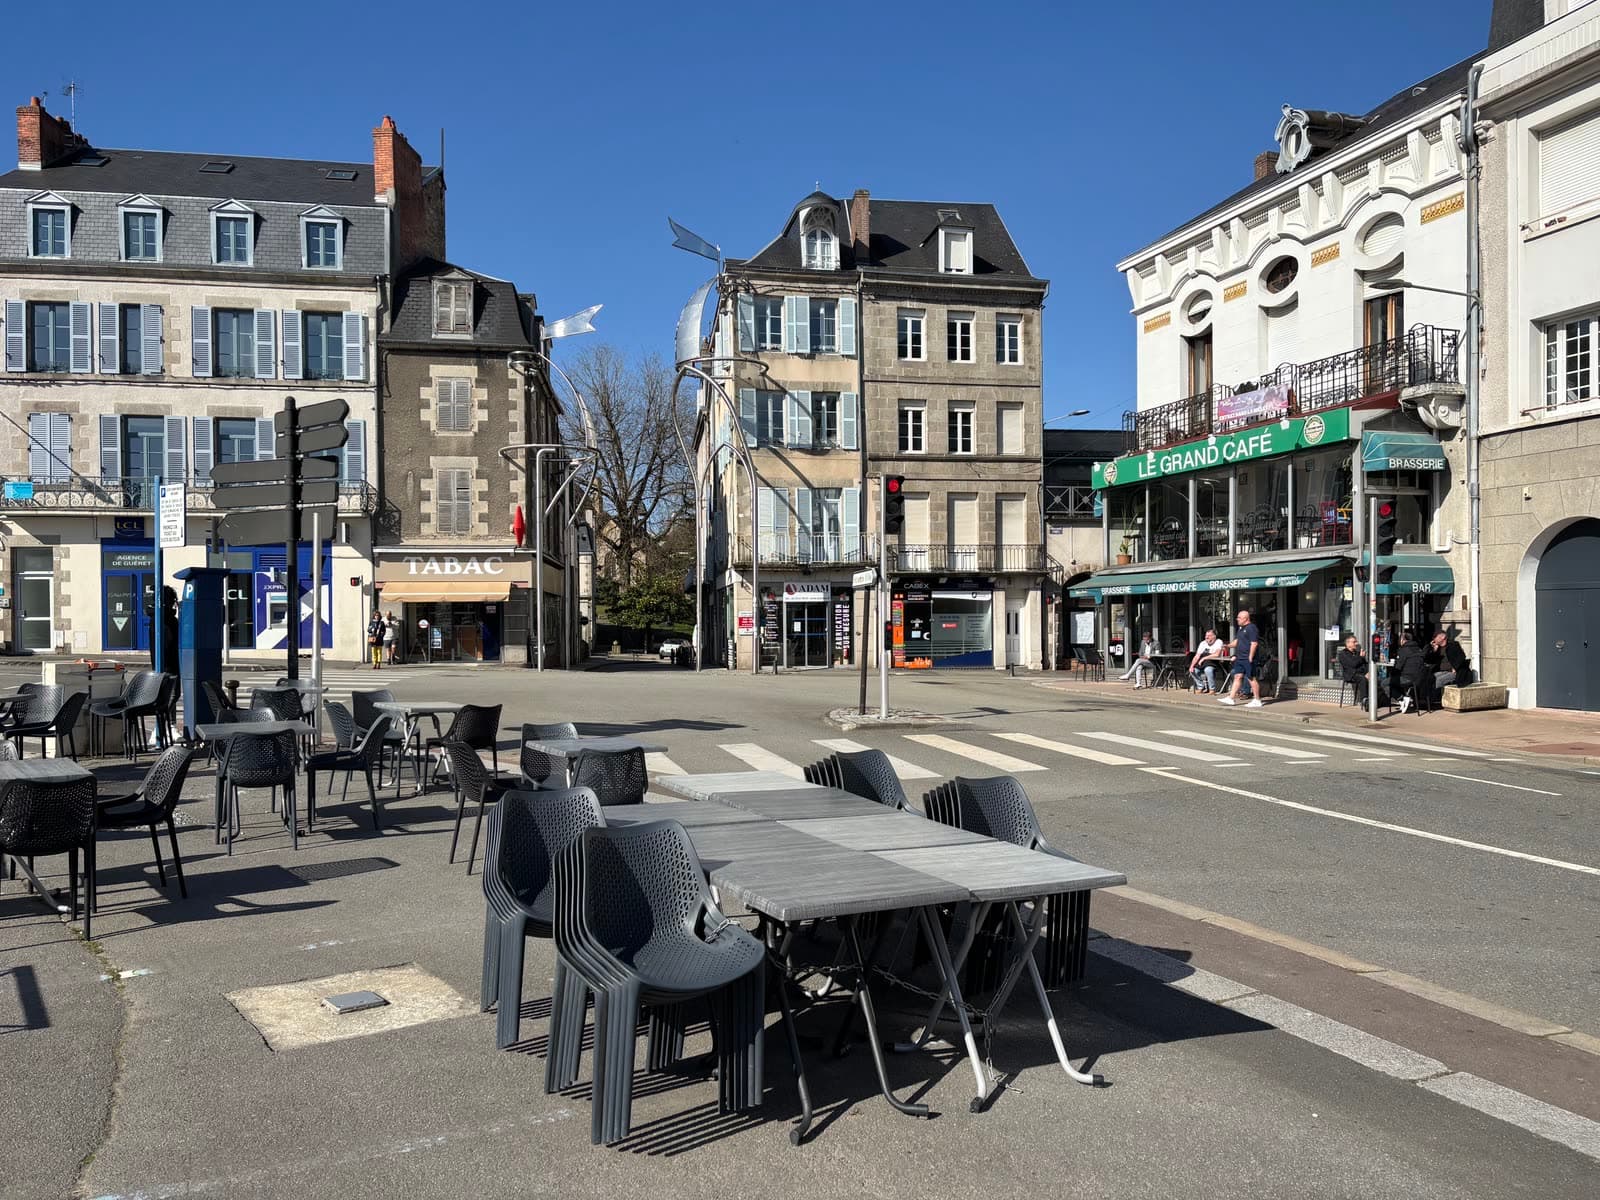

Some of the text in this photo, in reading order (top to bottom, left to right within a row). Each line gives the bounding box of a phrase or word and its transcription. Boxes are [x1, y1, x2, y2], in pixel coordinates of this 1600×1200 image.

[1138, 458, 1157, 478] LE
[1160, 445, 1219, 474] GRAND
[1222, 428, 1273, 461] CAFÉ
[1389, 458, 1444, 469] BRASSERIE
[116, 521, 138, 530] LCL
[123, 559, 152, 567] GUÉRET
[402, 556, 504, 575] TABAC
[186, 583, 194, 599] P
[798, 583, 830, 593] ADAM
[1100, 585, 1132, 596] BRASSERIE
[1147, 583, 1156, 593] LE
[1156, 582, 1179, 592] GRAND
[1209, 578, 1250, 590] BRASSERIE
[1411, 582, 1432, 593] BAR
[224, 589, 249, 600] CL
[835, 604, 843, 650] FABRICATION
